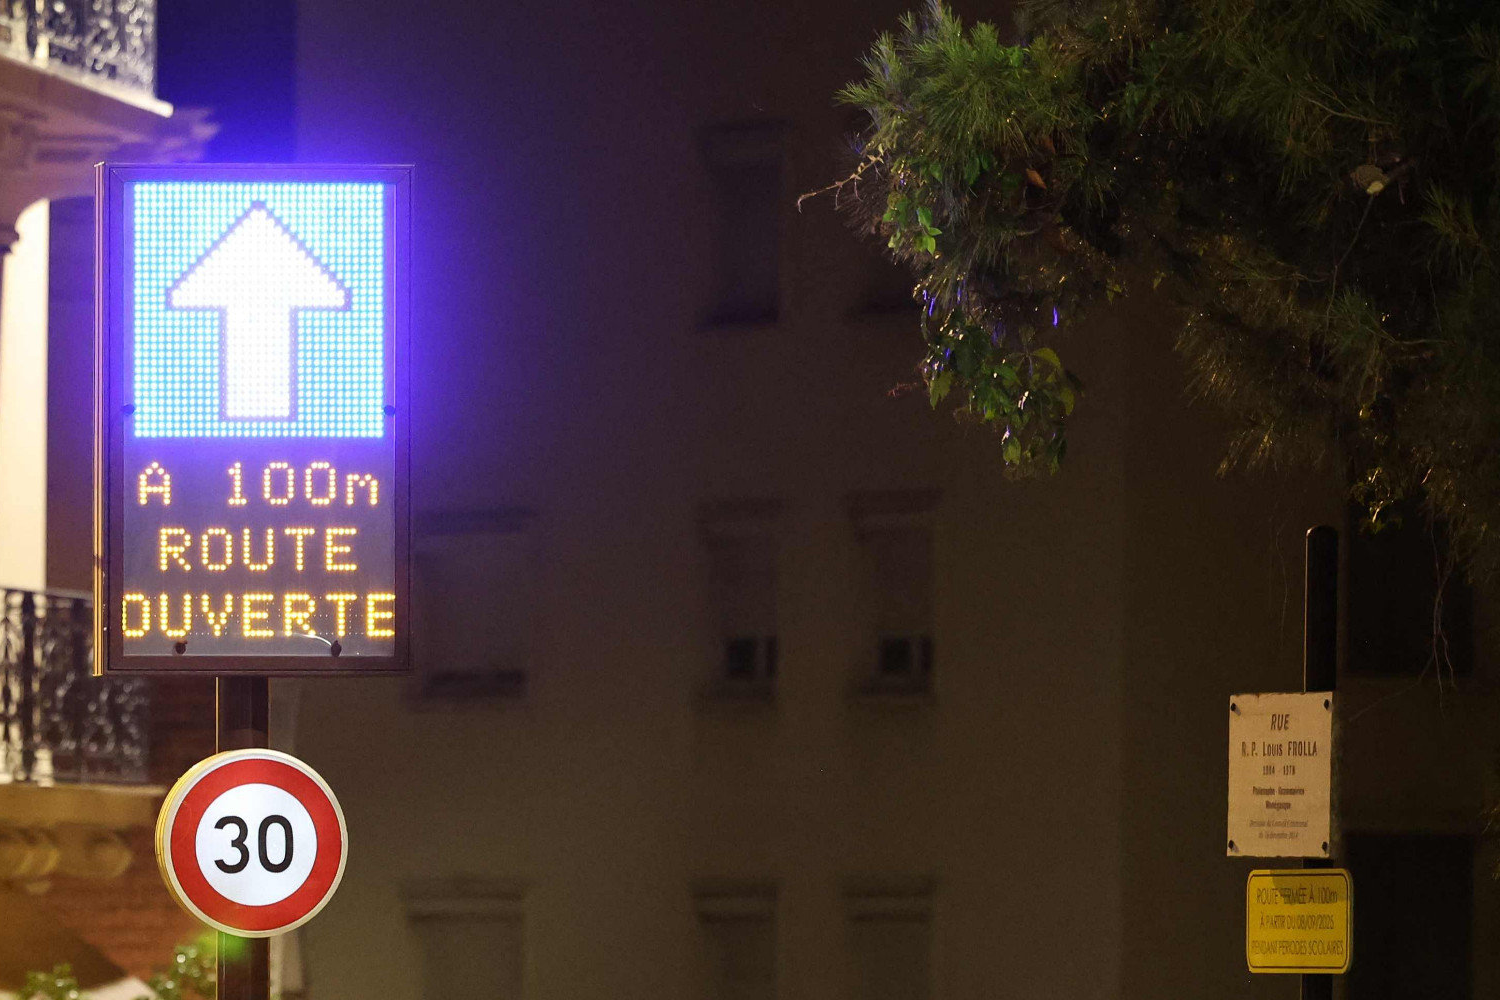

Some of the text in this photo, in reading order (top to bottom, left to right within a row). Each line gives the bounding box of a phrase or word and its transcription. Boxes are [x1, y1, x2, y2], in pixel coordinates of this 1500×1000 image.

[137, 461, 379, 505] A 100m
[159, 527, 357, 571] ROUTE
[122, 594, 396, 637] OUVERTE
[1270, 713, 1290, 731] RUE
[1288, 740, 1318, 756] FROLLA
[214, 814, 294, 874] 30
